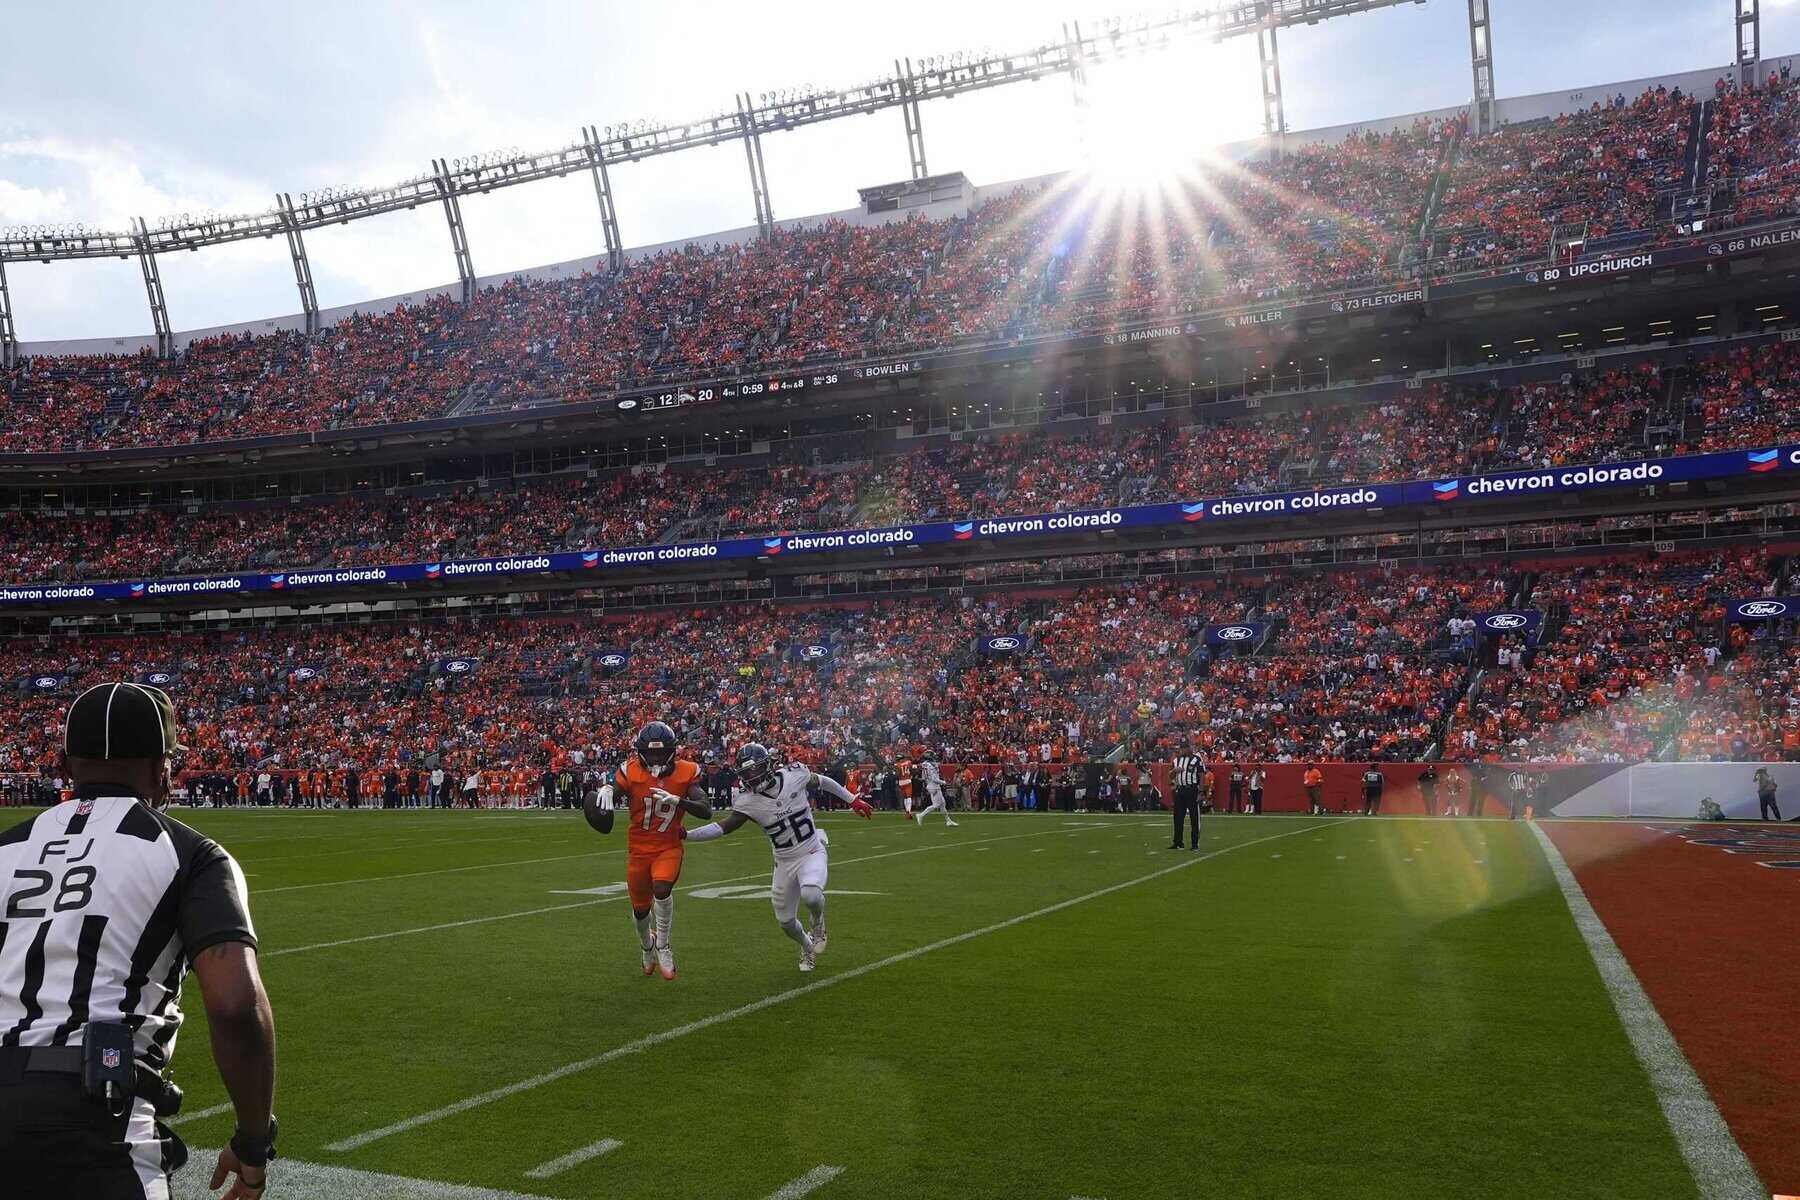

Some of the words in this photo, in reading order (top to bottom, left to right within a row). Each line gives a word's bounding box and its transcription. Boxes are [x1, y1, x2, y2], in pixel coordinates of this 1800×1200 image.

[1728, 239, 1745, 252] 66
[1543, 268, 1560, 281] 80
[1569, 255, 1652, 278] UPCHURCH
[1346, 299, 1359, 311] 73
[1362, 290, 1422, 308] FLETCHER
[1239, 311, 1282, 326] MILLER
[1117, 334, 1127, 343] 18
[1130, 326, 1181, 342] MANNING
[865, 363, 909, 377] BOWLEN
[769, 383, 779, 391] 40
[825, 375, 838, 384] 36
[698, 389, 713, 401] 20
[722, 388, 736, 397] 4TH
[742, 384, 763, 395] 0:59
[659, 394, 673, 406] 12
[1467, 474, 1554, 494] chevron
[1561, 462, 1663, 486] colorado
[1211, 496, 1285, 515] chevron
[1291, 488, 1377, 509] colorado
[979, 518, 1043, 535] chevron
[1048, 510, 1122, 529] colorado
[787, 534, 844, 550] chevron
[848, 528, 914, 545] colorado
[603, 548, 655, 563] chevron
[658, 544, 717, 559] colorado
[444, 560, 492, 574] chevron
[495, 556, 550, 571] colorado
[148, 581, 195, 593] chevron
[198, 577, 241, 591] colorado
[288, 572, 333, 586] chevron
[335, 567, 386, 582] colorado
[45, 586, 94, 599] colorado
[642, 797, 678, 832] 19
[763, 807, 816, 849] 26
[39, 838, 95, 864] FJ
[6, 865, 97, 919] 28
